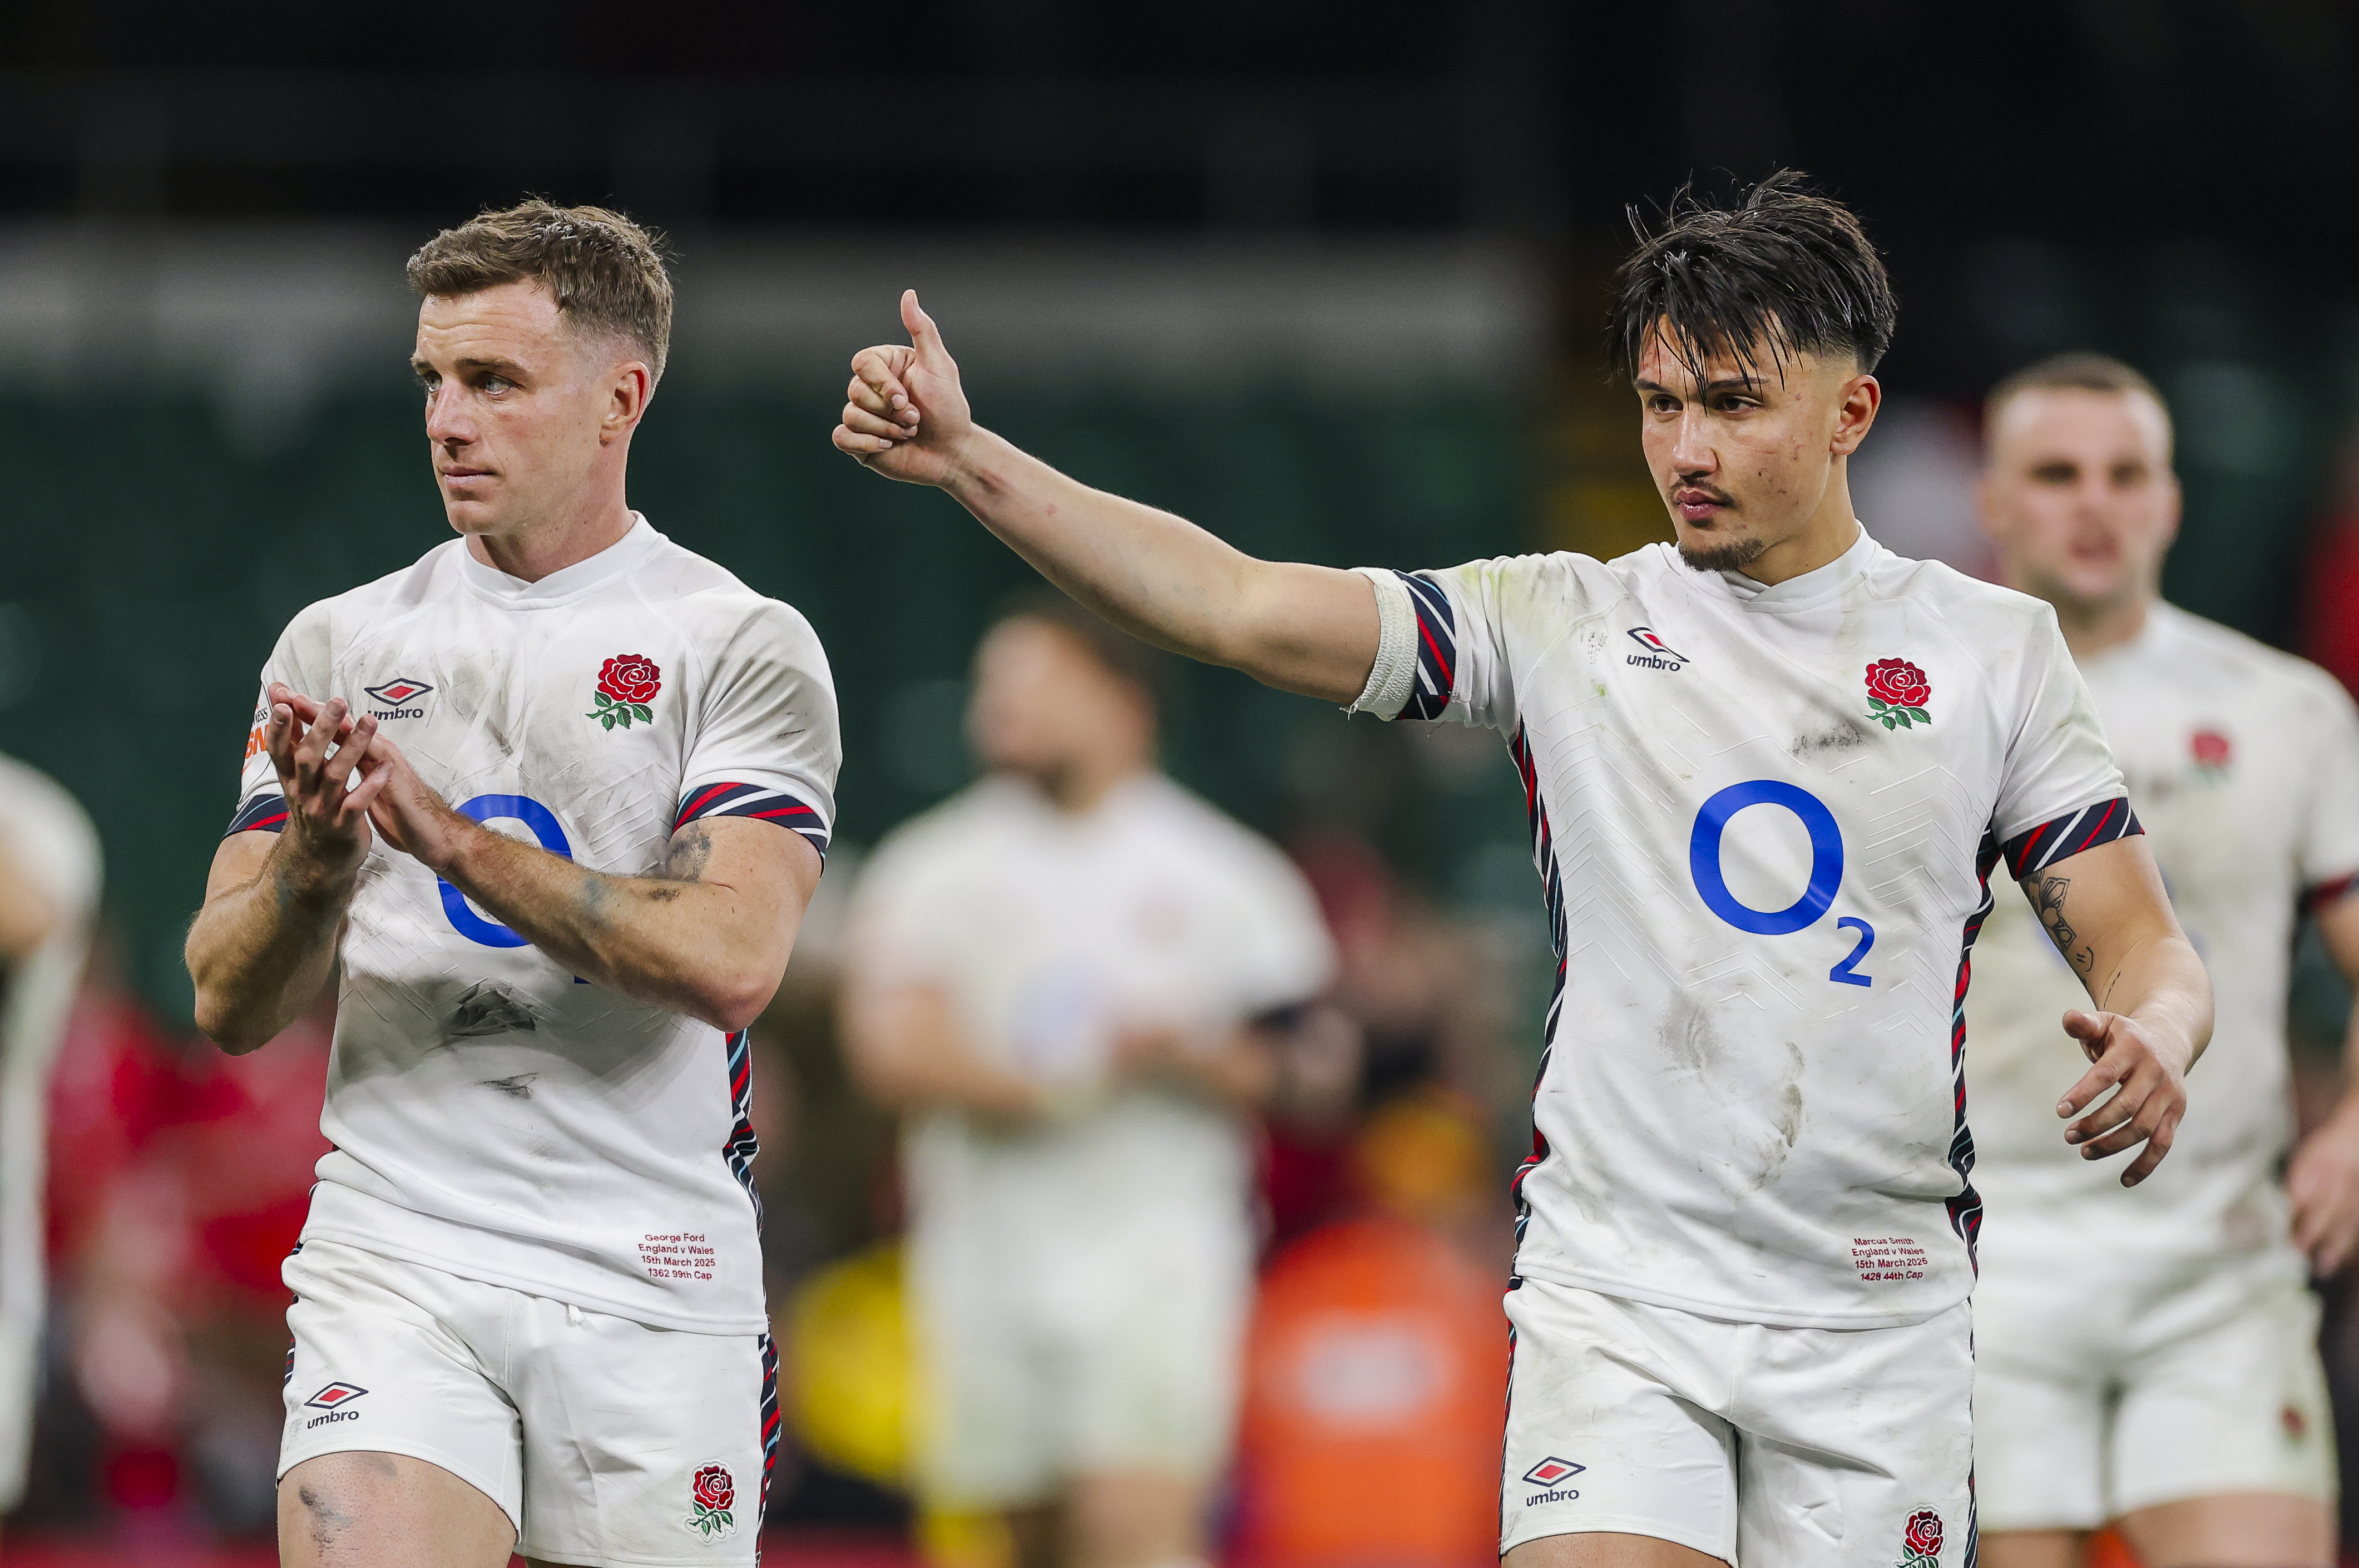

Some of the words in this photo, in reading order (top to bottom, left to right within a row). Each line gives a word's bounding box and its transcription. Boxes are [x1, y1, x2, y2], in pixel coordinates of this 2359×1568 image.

[1626, 655, 1681, 672] umbro
[1690, 780, 1875, 987] O2
[645, 1234, 681, 1243] George
[684, 1233, 705, 1242] Ford
[638, 1244, 677, 1254] England
[688, 1245, 714, 1254] Wales
[1852, 1248, 1890, 1258] England
[641, 1255, 661, 1264] 15th
[664, 1257, 691, 1267] March
[1855, 1259, 1875, 1269] 15th
[1878, 1258, 1906, 1268] March
[647, 1268, 670, 1277] 1362
[673, 1270, 692, 1279] 99th
[694, 1271, 712, 1281] Cap
[1860, 1272, 1881, 1282] 1428
[1883, 1272, 1903, 1280] 44th
[1906, 1270, 1923, 1280] Cap
[307, 1411, 359, 1429] umbro
[1526, 1489, 1580, 1507] umbro
